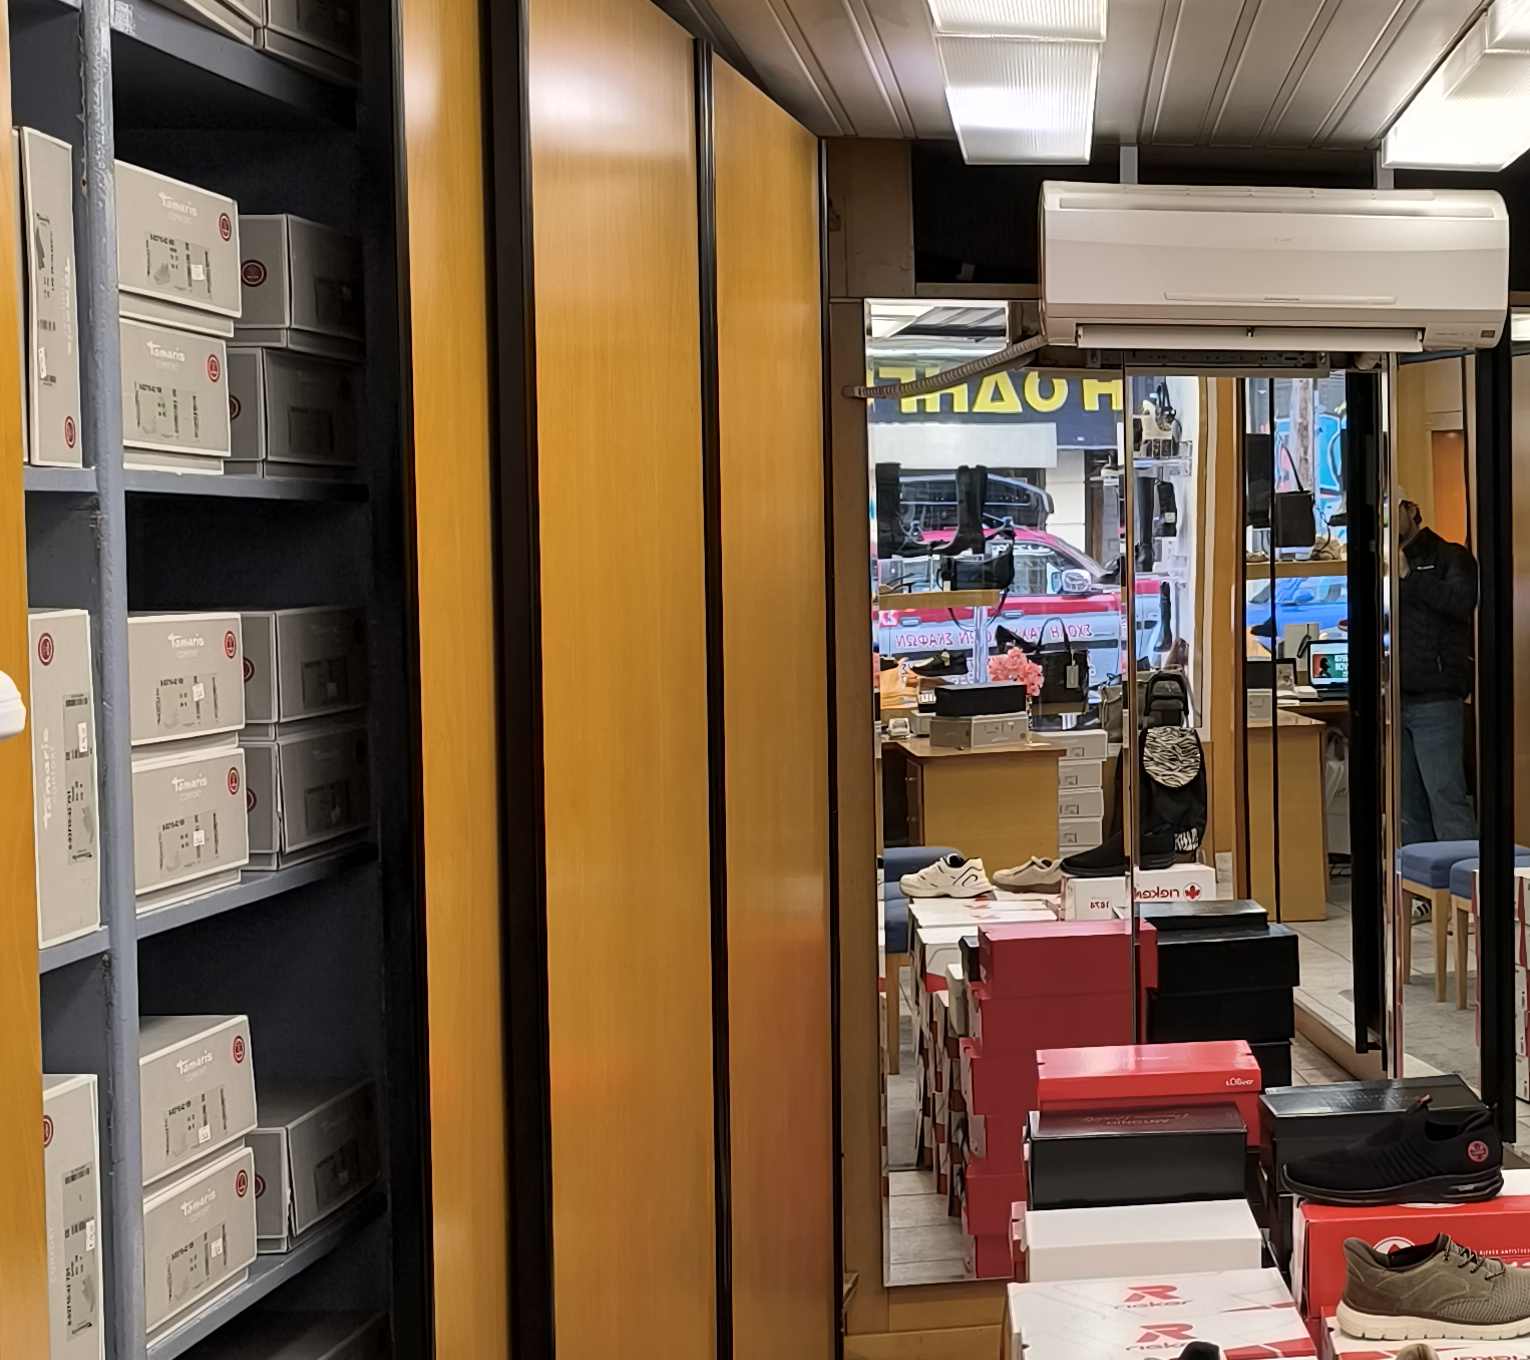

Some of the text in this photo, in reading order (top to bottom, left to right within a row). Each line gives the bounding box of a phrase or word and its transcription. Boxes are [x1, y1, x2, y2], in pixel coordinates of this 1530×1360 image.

[157, 191, 198, 217] Tamaris
[147, 341, 185, 362] Tamaris
[167, 632, 204, 648] Tamaris
[43, 727, 52, 830] Tamaris
[170, 773, 207, 791] Tamaris
[176, 1050, 213, 1074] Tamaris
[180, 1188, 216, 1217] Tamaris
